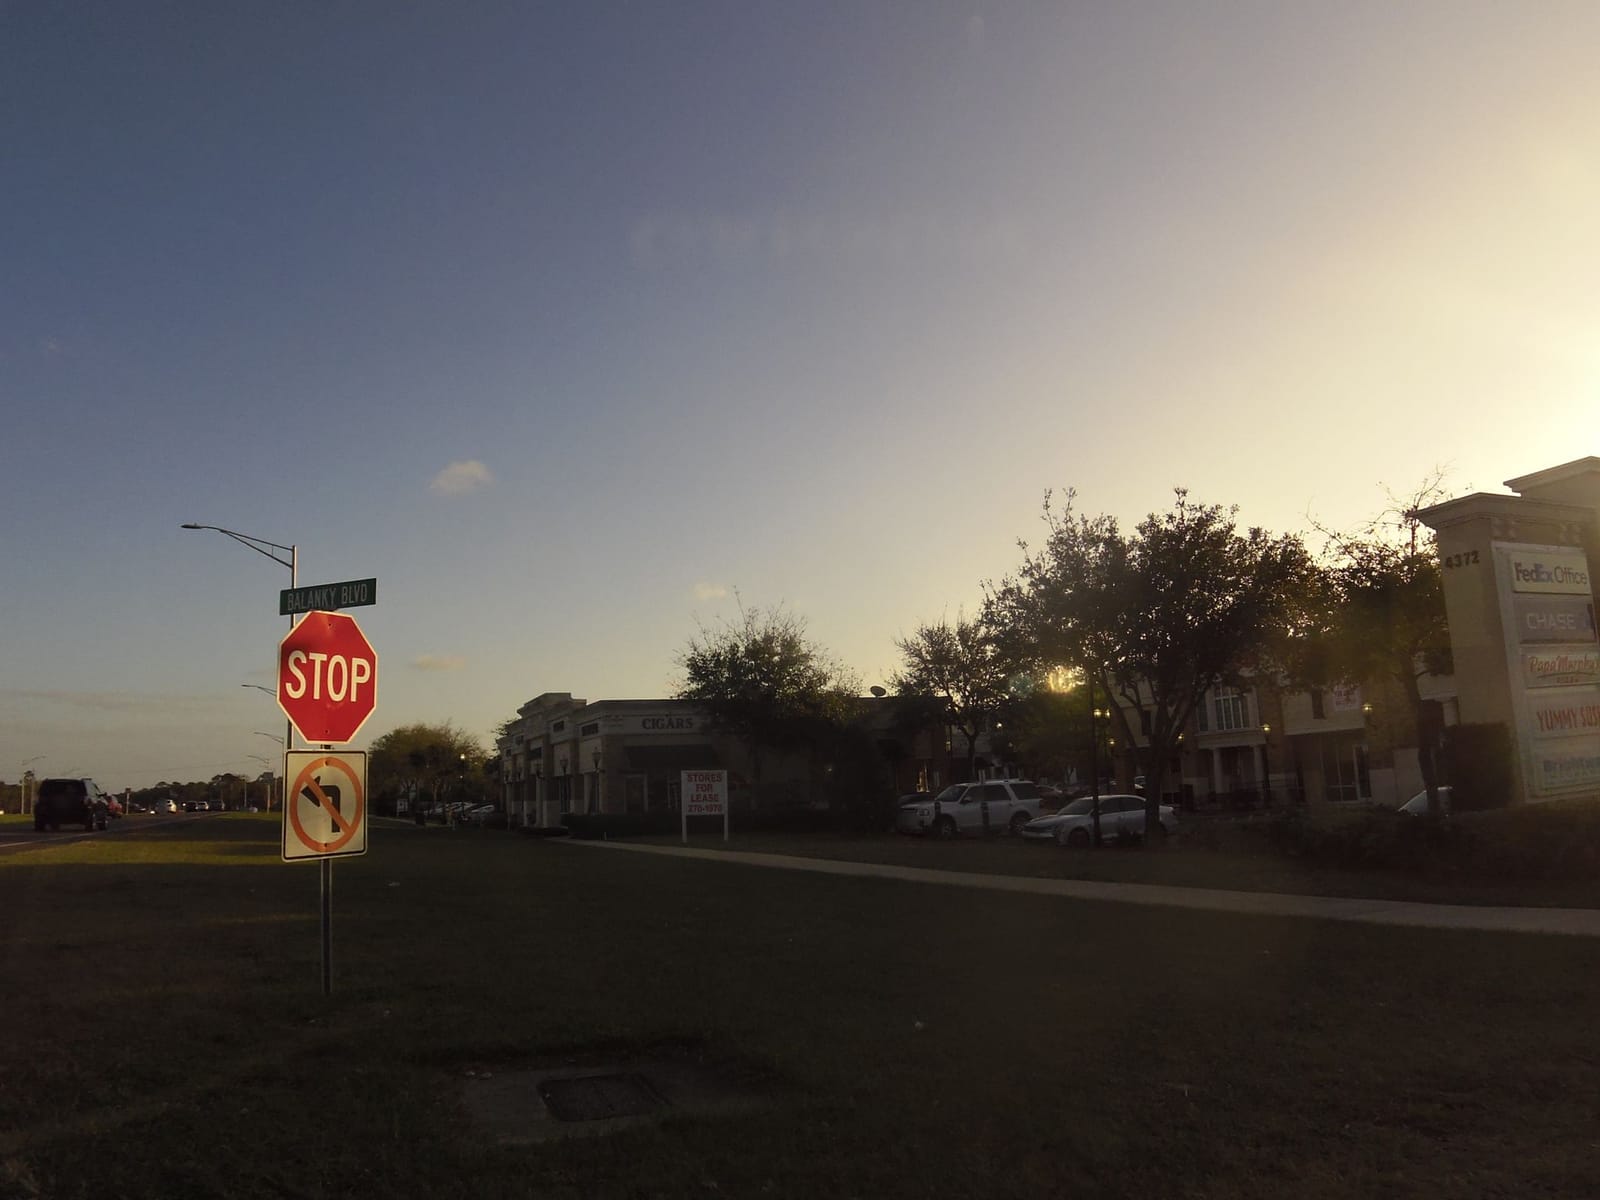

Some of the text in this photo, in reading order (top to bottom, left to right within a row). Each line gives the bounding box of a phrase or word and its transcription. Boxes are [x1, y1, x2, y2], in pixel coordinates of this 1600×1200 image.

[1445, 550, 1480, 568] 4372
[1514, 562, 1588, 585] FedEx Office
[287, 583, 368, 611] BALANKY BLVD
[1527, 612, 1577, 630] CHASE
[285, 650, 371, 702] STOP
[642, 718, 693, 730] CIGARS
[1536, 708, 1577, 732] YUMMY
[687, 774, 722, 782] STORES
[695, 783, 712, 792] FOR
[690, 793, 719, 802] LEASE
